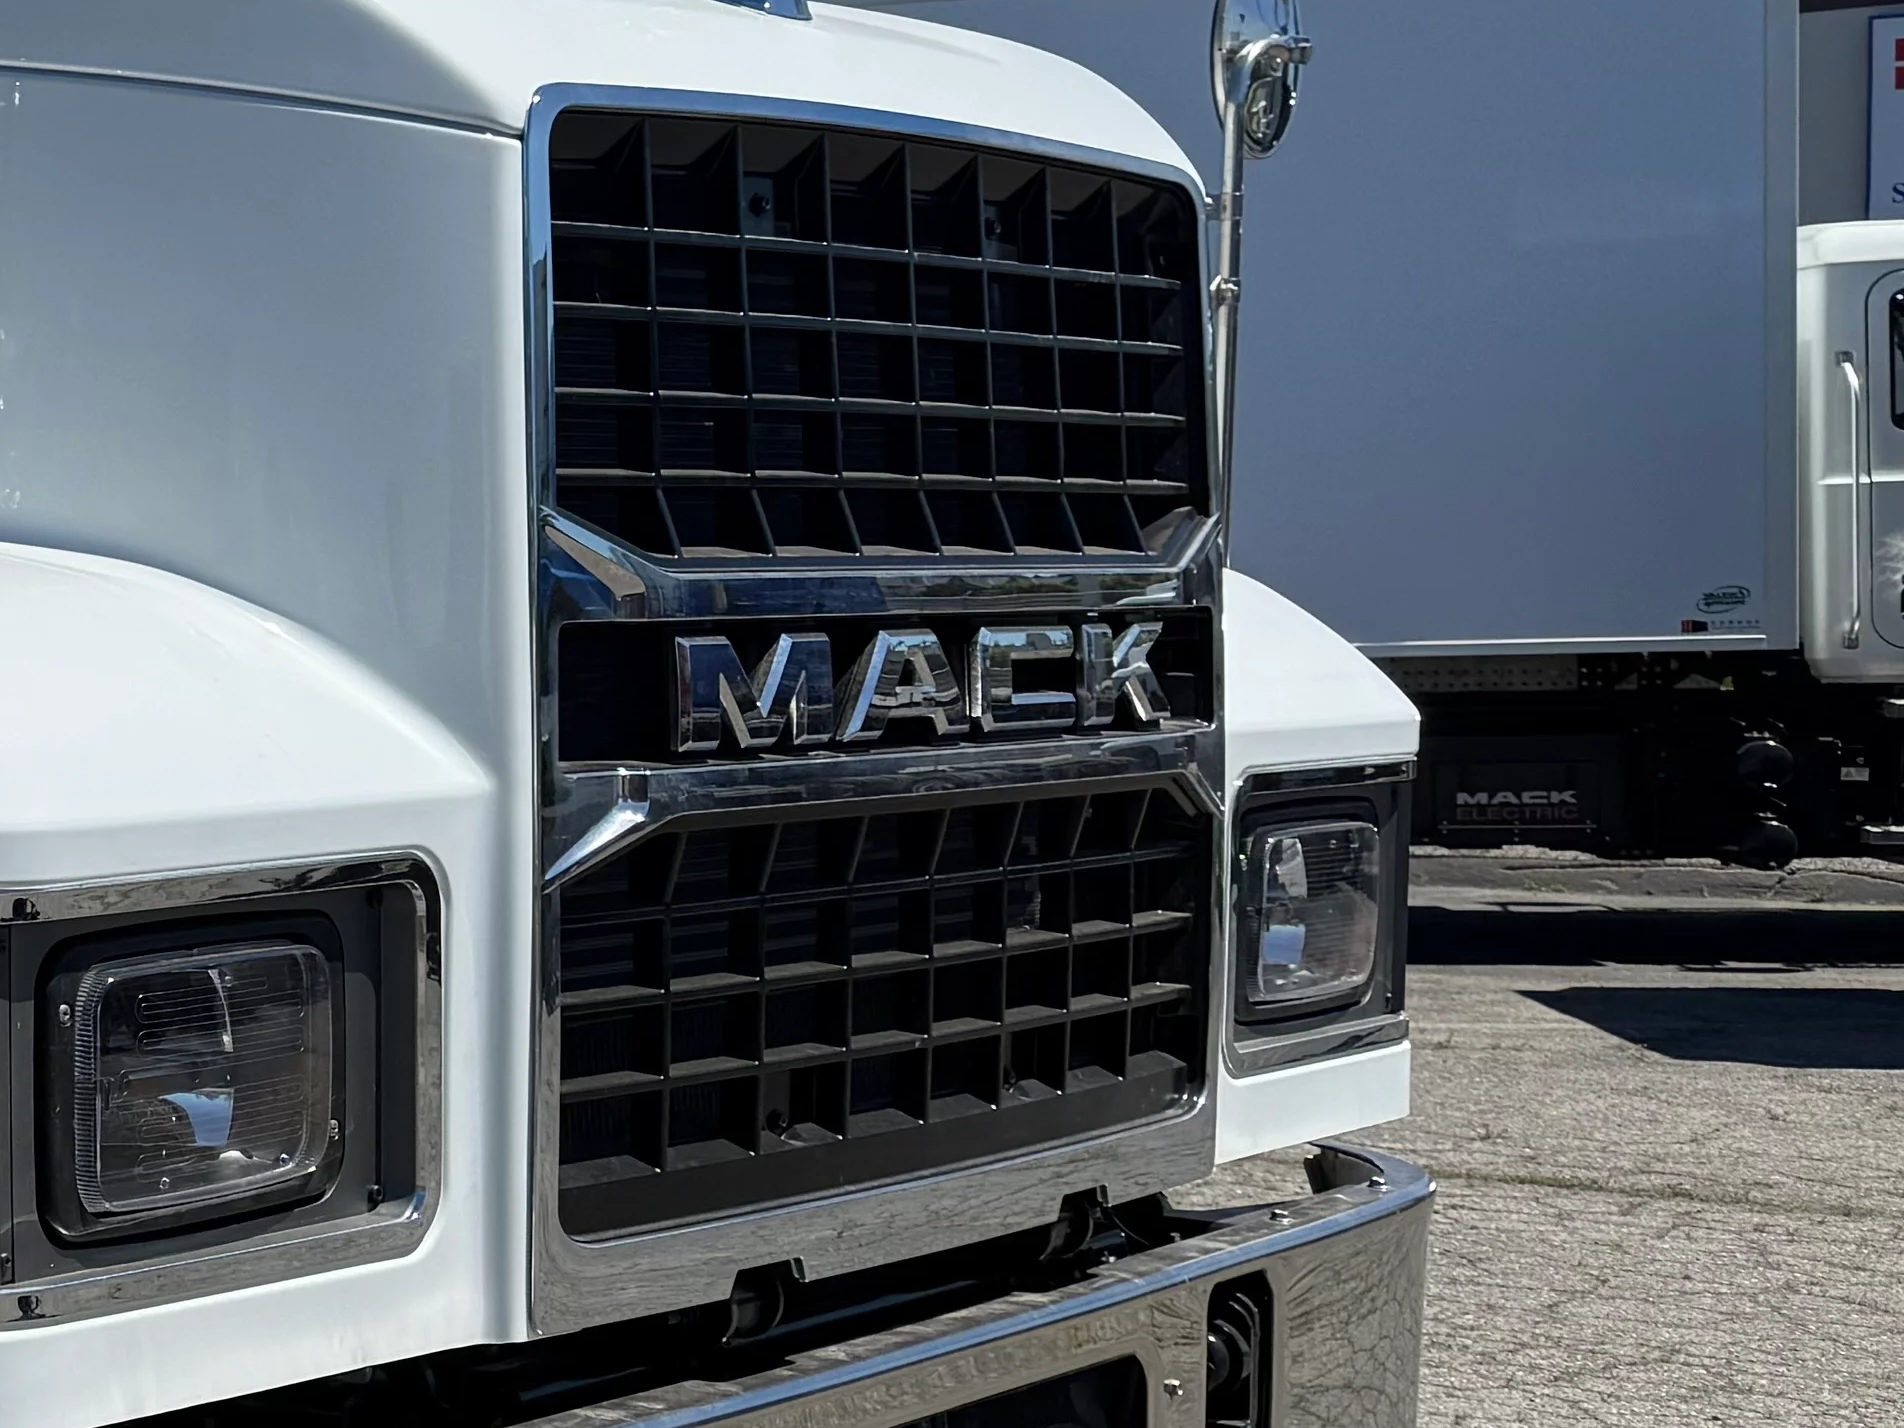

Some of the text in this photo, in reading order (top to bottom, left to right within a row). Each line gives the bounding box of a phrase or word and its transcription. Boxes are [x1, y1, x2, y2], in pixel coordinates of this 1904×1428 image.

[673, 621, 1171, 752] MACK
[1456, 790, 1578, 805] MACK
[1456, 805, 1579, 821] ELECTRIC
